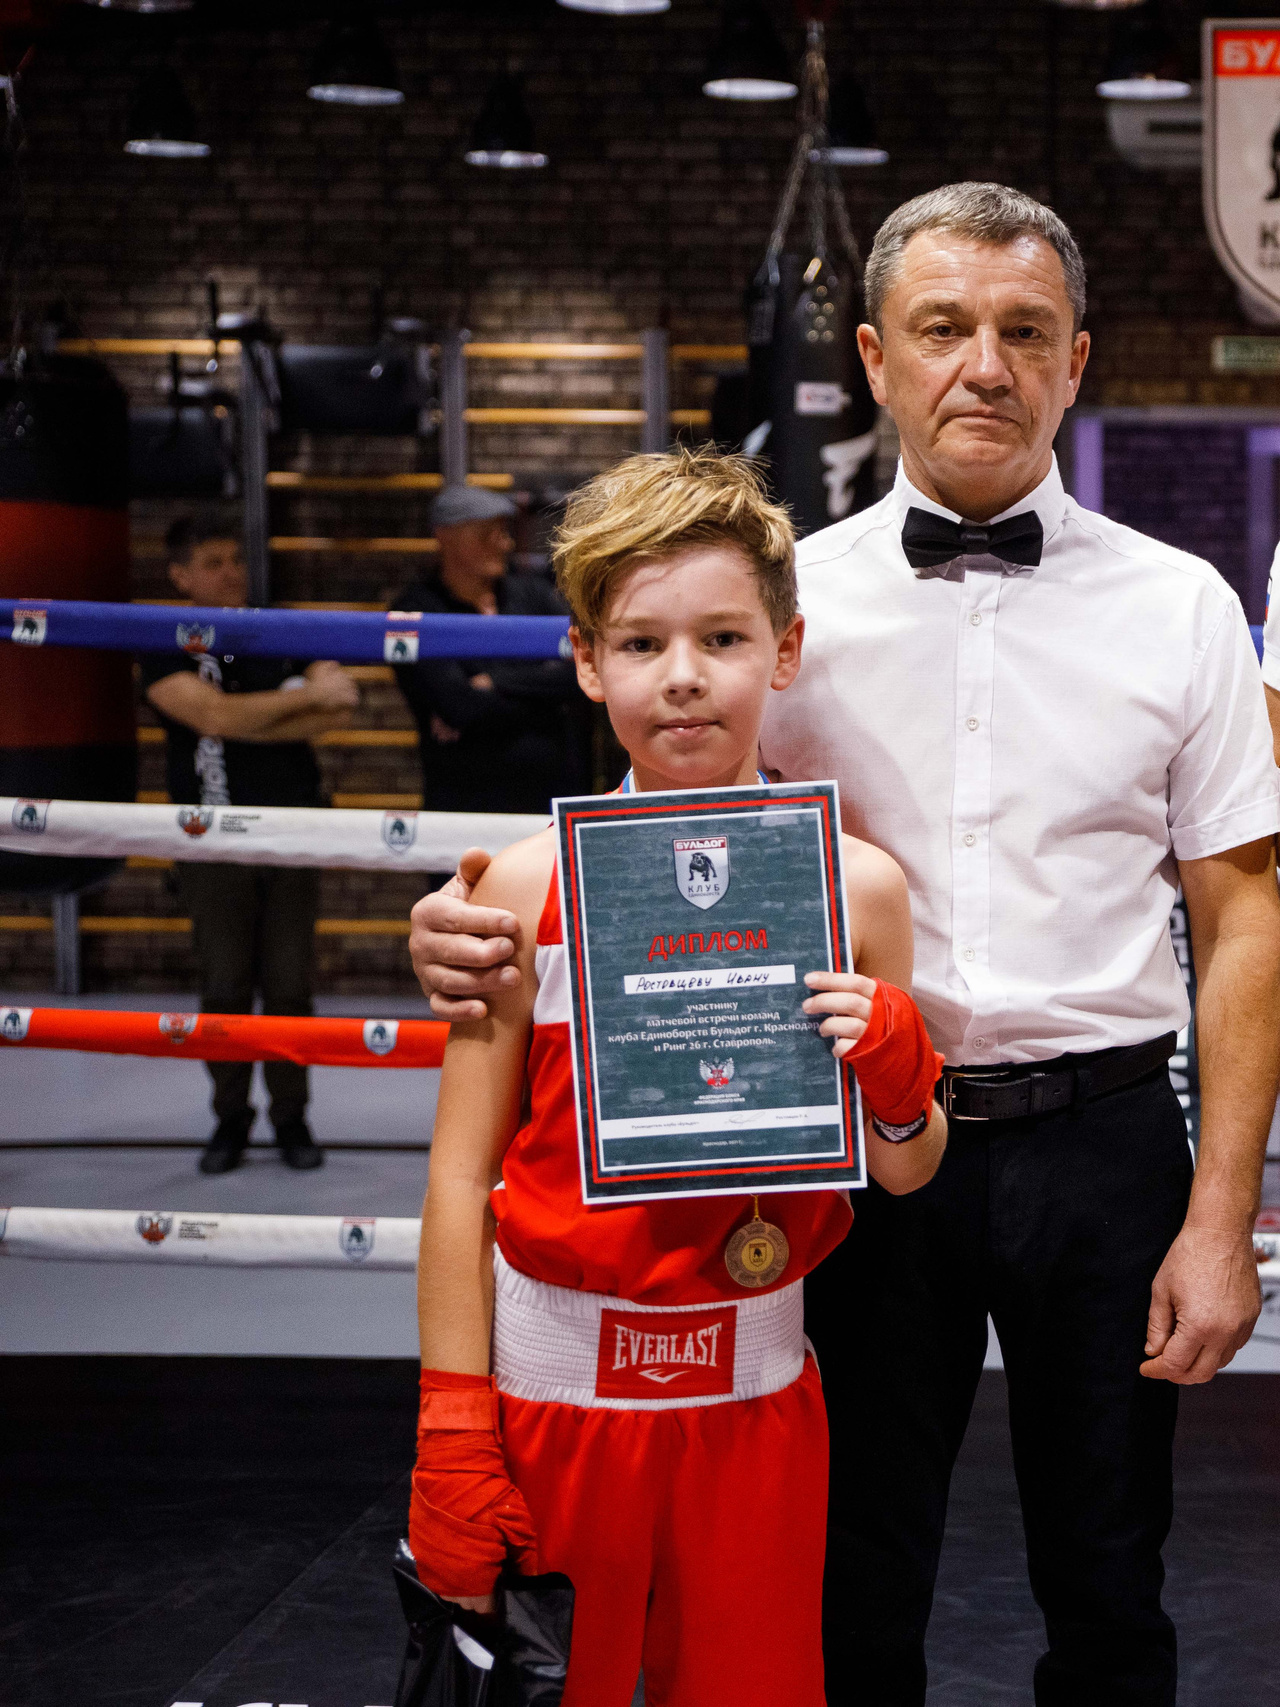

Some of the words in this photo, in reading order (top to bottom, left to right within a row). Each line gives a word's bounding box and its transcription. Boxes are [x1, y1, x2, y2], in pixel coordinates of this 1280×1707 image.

[676, 839, 725, 850] БУЛЬДОГ
[688, 884, 720, 893] КЛУБ
[648, 929, 768, 962] ДИПЛОМ
[686, 1002, 738, 1014] участнику
[646, 1015, 696, 1027] матчевой
[698, 1014, 739, 1025] встречи
[741, 1012, 780, 1021] команд
[608, 1032, 639, 1044] клуба
[641, 1028, 708, 1042] Единоборств
[710, 1026, 751, 1037] Бульдог
[764, 1021, 819, 1034] Краснодар
[663, 1042, 686, 1052] Ринг
[689, 1041, 701, 1050] 26
[713, 1037, 776, 1049] Ставрополь.
[612, 1322, 722, 1370] EVERLAST
